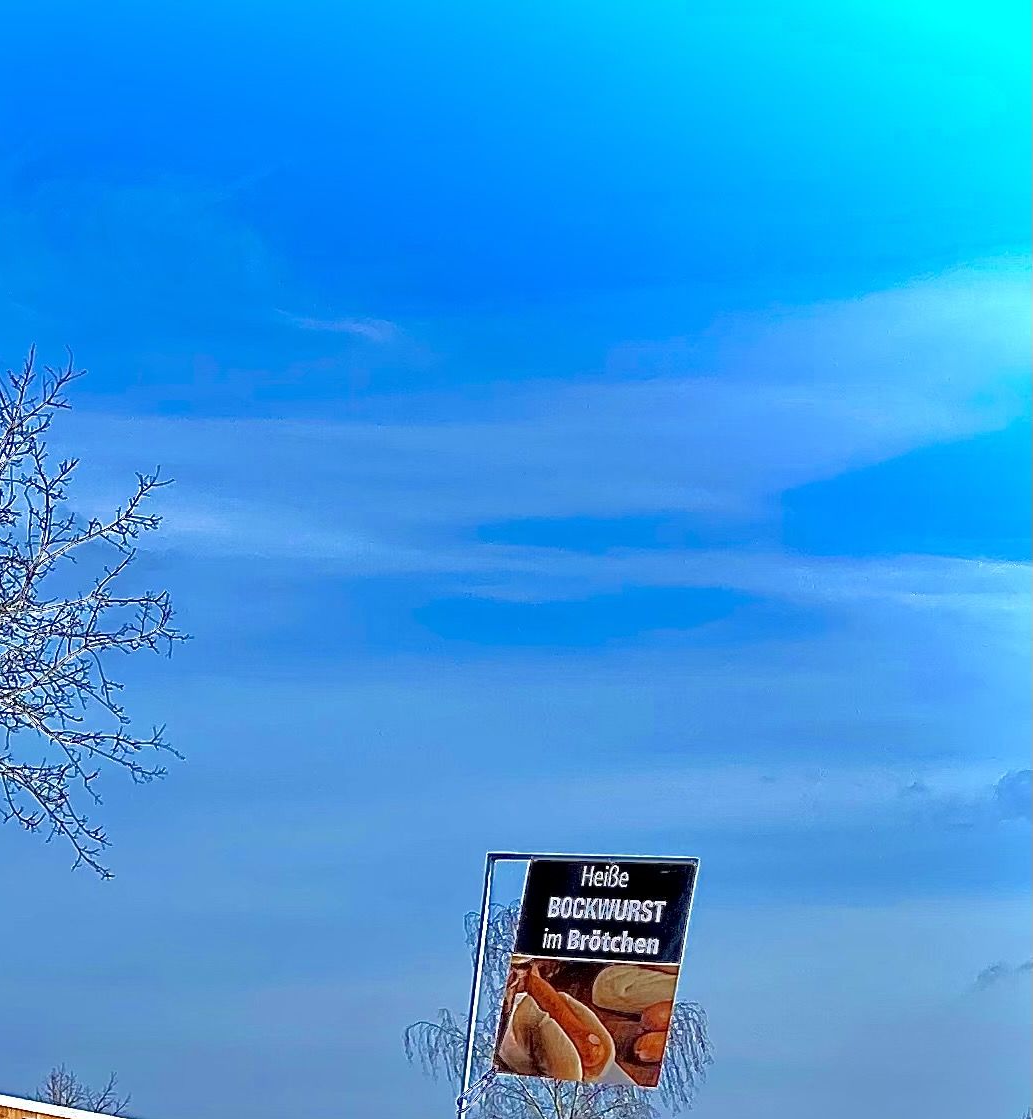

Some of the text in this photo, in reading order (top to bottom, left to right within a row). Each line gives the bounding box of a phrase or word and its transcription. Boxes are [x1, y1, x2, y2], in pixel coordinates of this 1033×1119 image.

[581, 864, 629, 888] Heiße
[547, 896, 667, 923] BOCKWURST
[542, 928, 659, 955] im Brötchen
